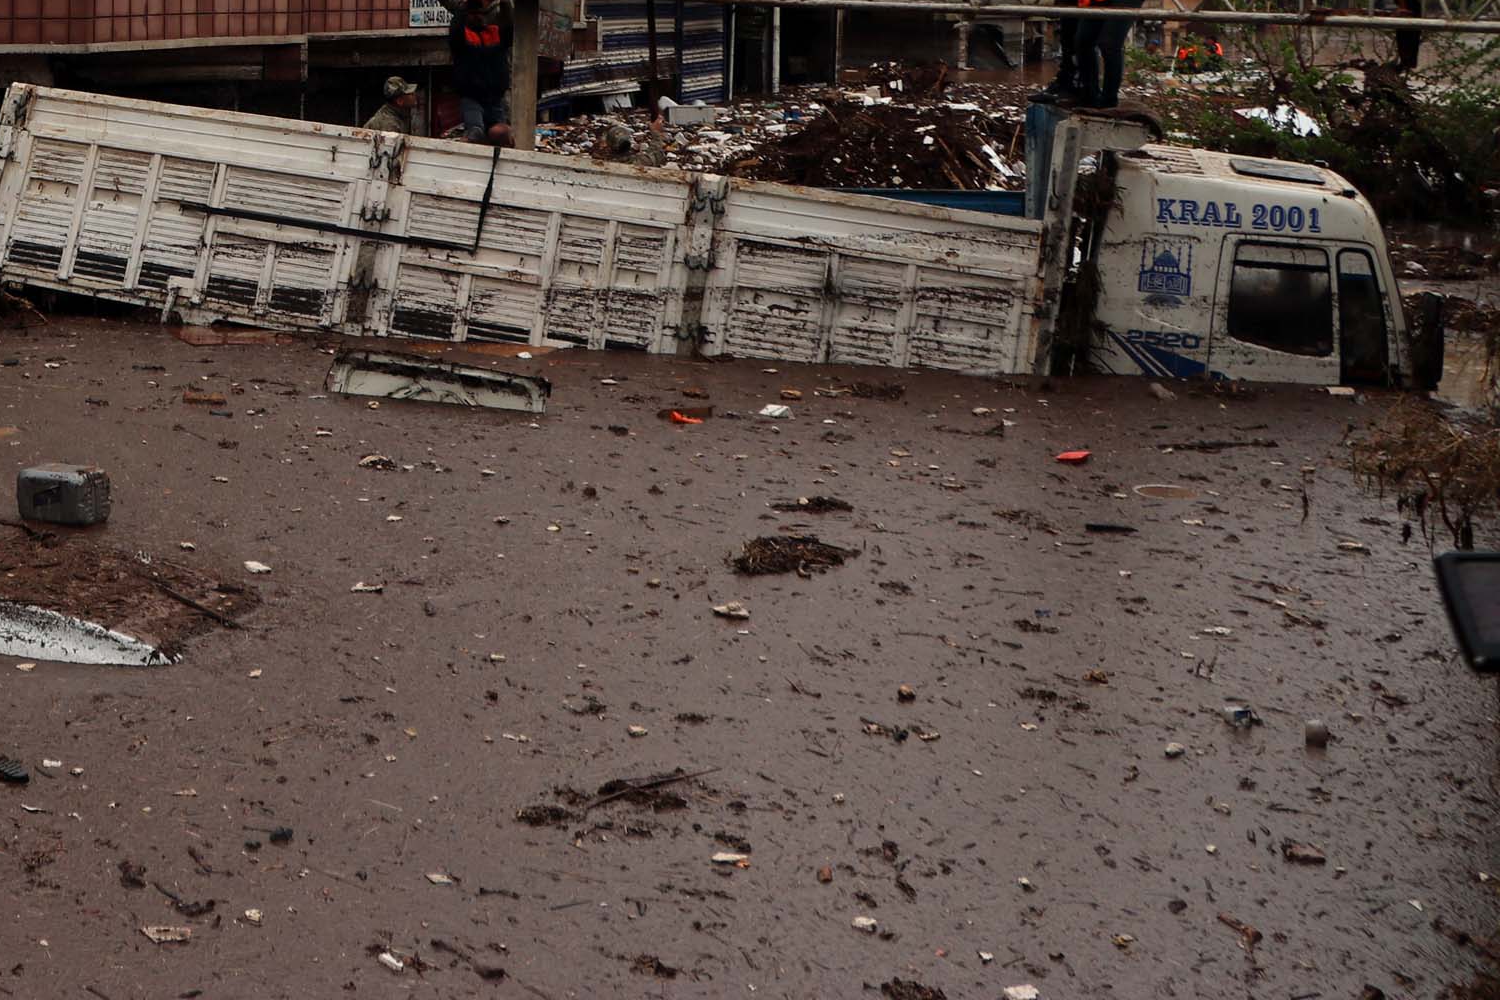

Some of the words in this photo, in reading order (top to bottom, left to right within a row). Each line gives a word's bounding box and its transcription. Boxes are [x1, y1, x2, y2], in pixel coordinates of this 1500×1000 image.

[1156, 198, 1242, 228] KRAL
[1251, 204, 1321, 233] 2001
[1127, 329, 1200, 349] 2520
